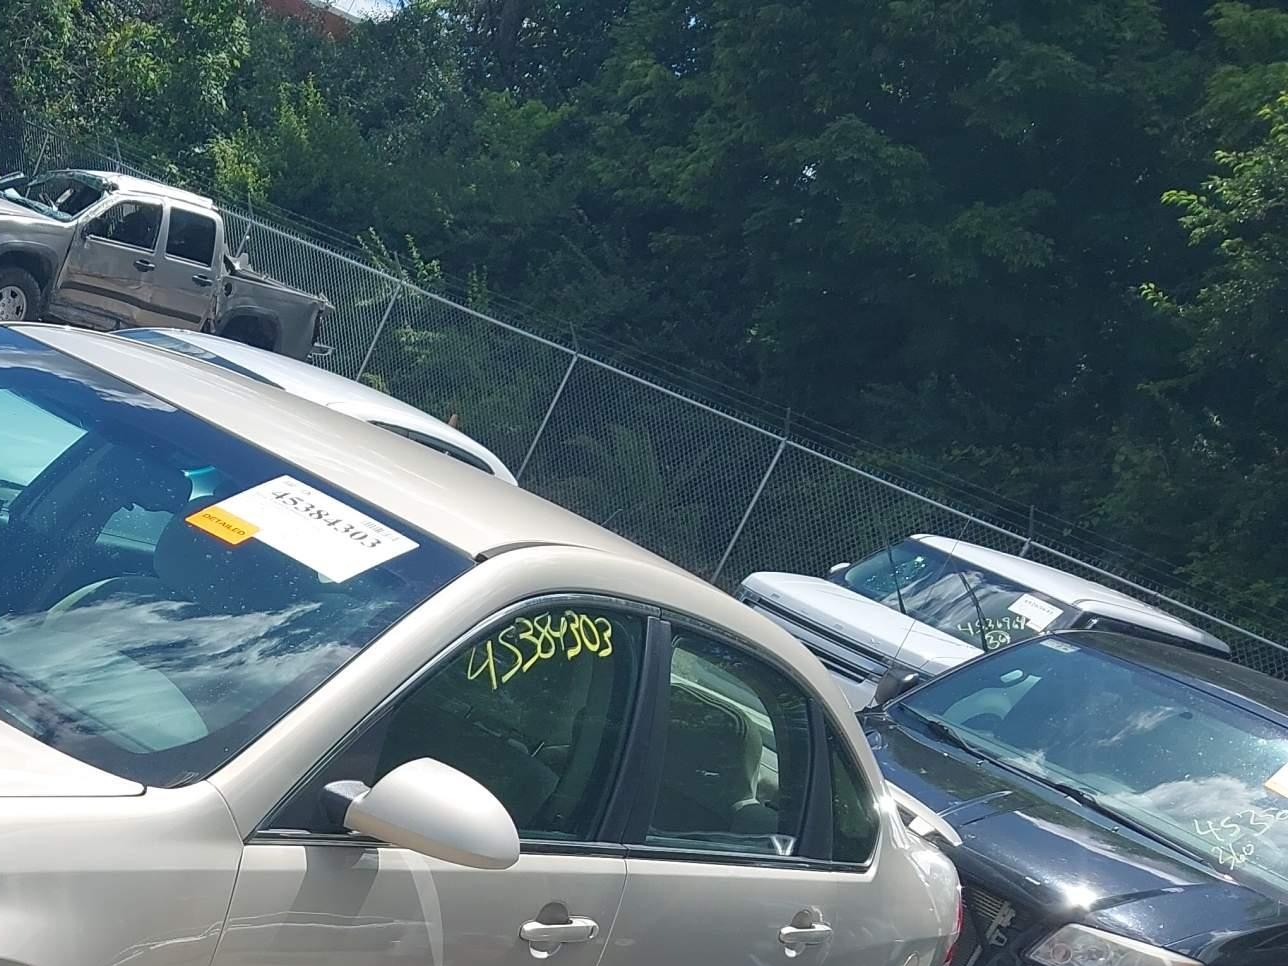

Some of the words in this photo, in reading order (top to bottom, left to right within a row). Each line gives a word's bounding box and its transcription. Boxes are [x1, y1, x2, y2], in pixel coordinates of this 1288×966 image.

[202, 513, 246, 536] DETAILED
[272, 489, 382, 549] 45384303
[466, 609, 613, 690] 45384303
